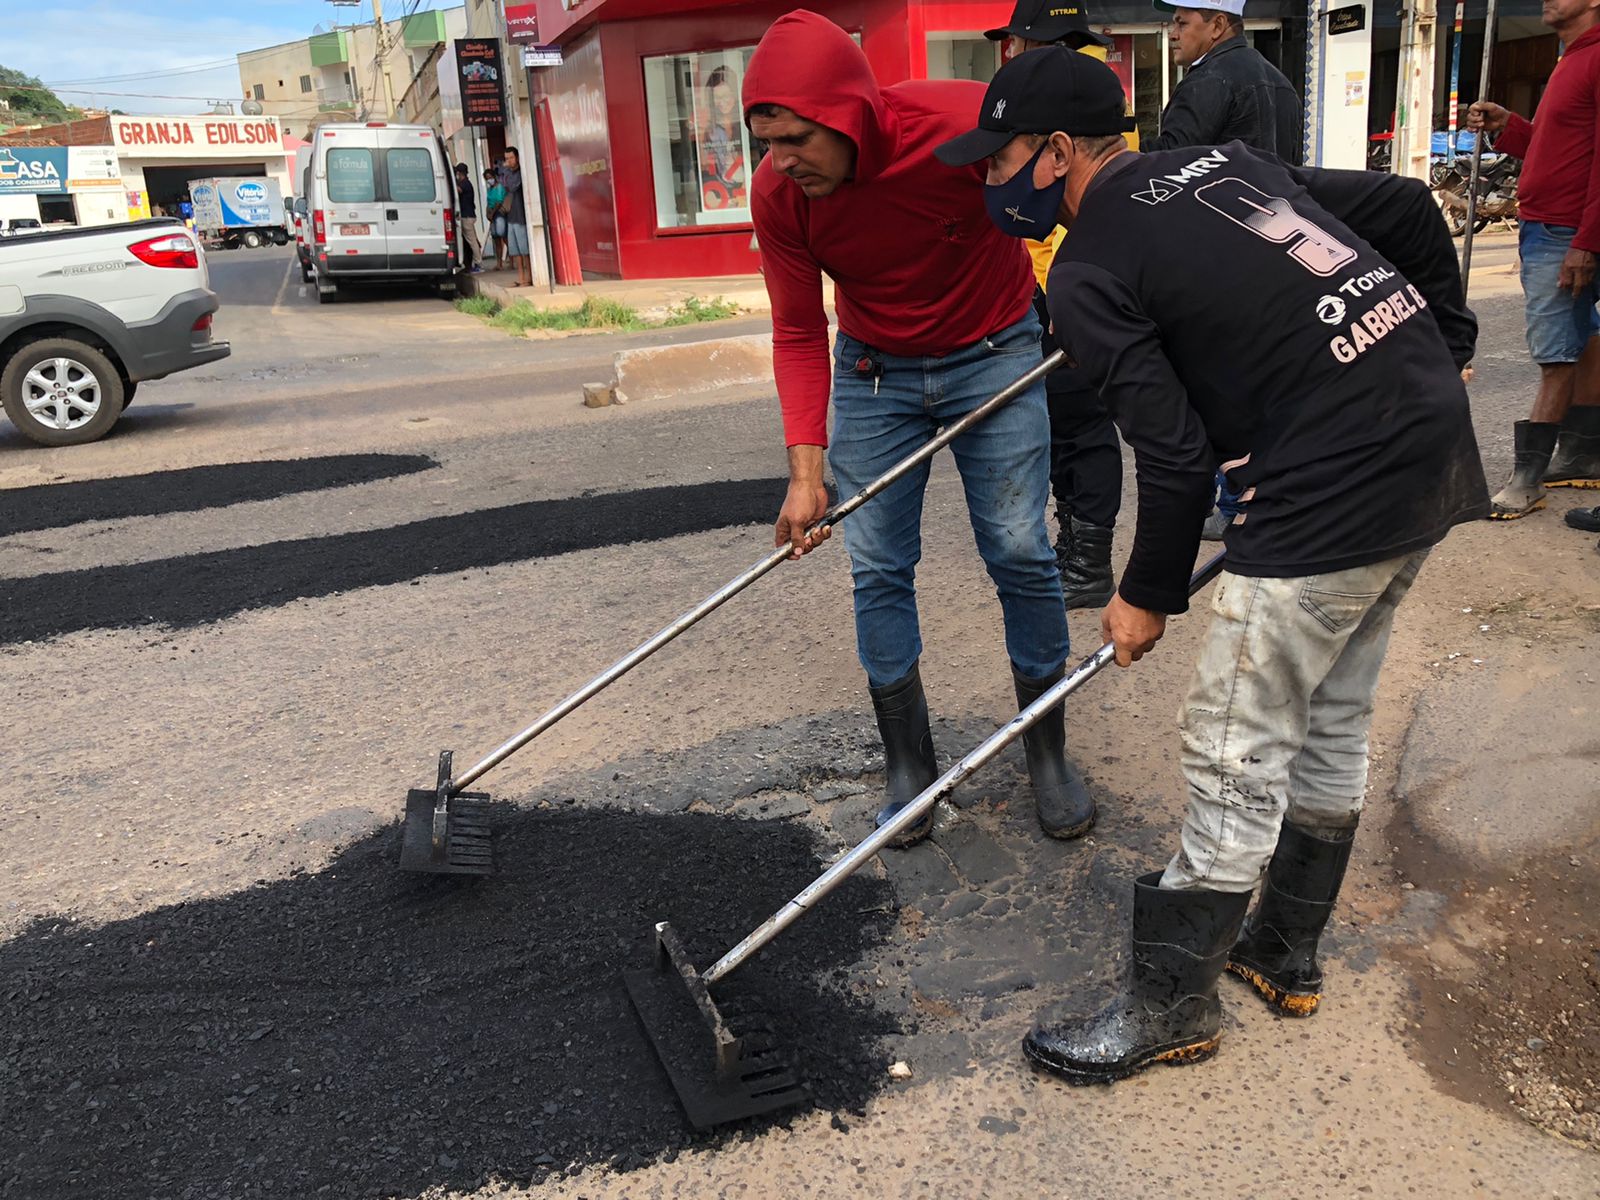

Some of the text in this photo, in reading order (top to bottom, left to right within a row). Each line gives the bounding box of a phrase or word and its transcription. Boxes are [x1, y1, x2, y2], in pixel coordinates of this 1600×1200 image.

[1049, 7, 1078, 17] STTRAM
[119, 122, 278, 145] GRANJA EDILSON
[1164, 149, 1229, 184] MRV
[1194, 177, 1358, 277] 9
[1329, 289, 1417, 364] GABRIEL
